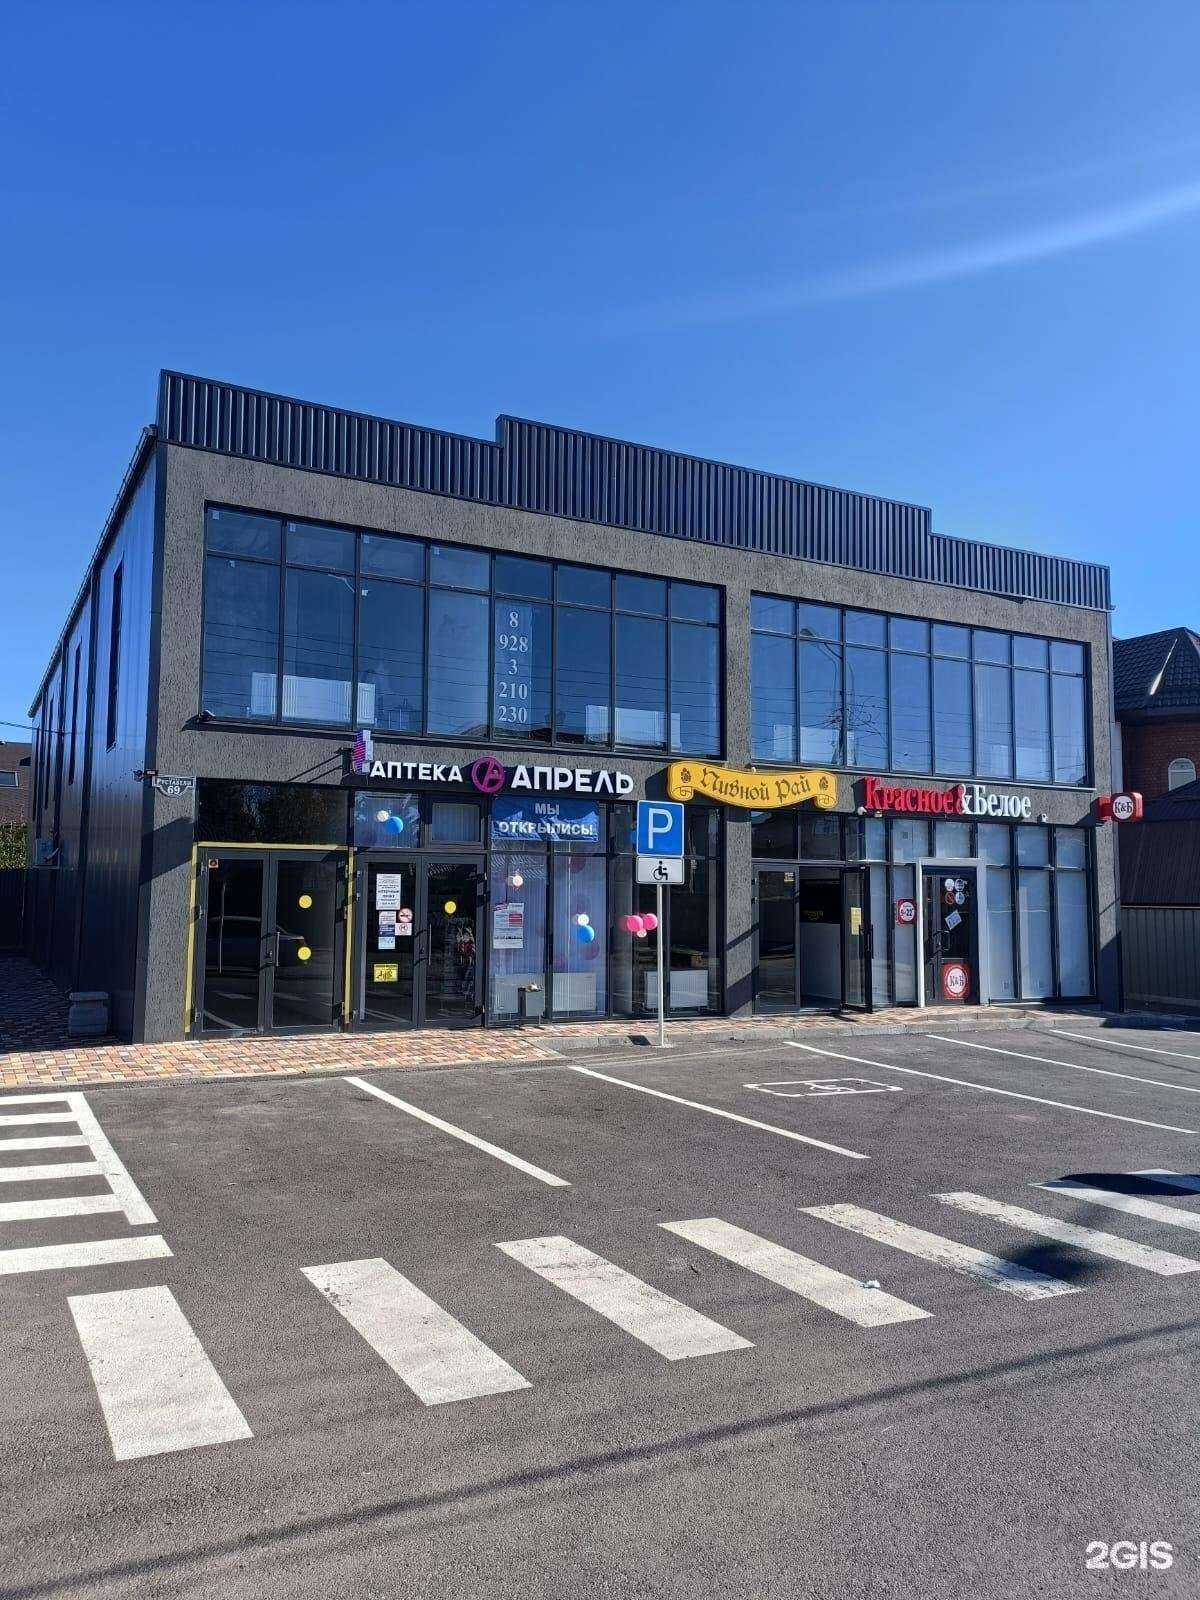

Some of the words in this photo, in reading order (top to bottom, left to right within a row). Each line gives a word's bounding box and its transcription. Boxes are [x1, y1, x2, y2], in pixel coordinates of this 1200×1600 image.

[509, 611, 519, 628] 8
[499, 634, 529, 653] 928
[508, 659, 518, 675] 3
[499, 682, 528, 700] 210
[498, 705, 528, 724] 230
[369, 760, 464, 783] АПТЕКА
[510, 765, 634, 795] АПРЕЛЬ
[701, 767, 770, 801] Пивной
[775, 774, 812, 804] Рай
[167, 785, 180, 795] 69
[534, 802, 560, 816] МЫ
[648, 807, 674, 850] P
